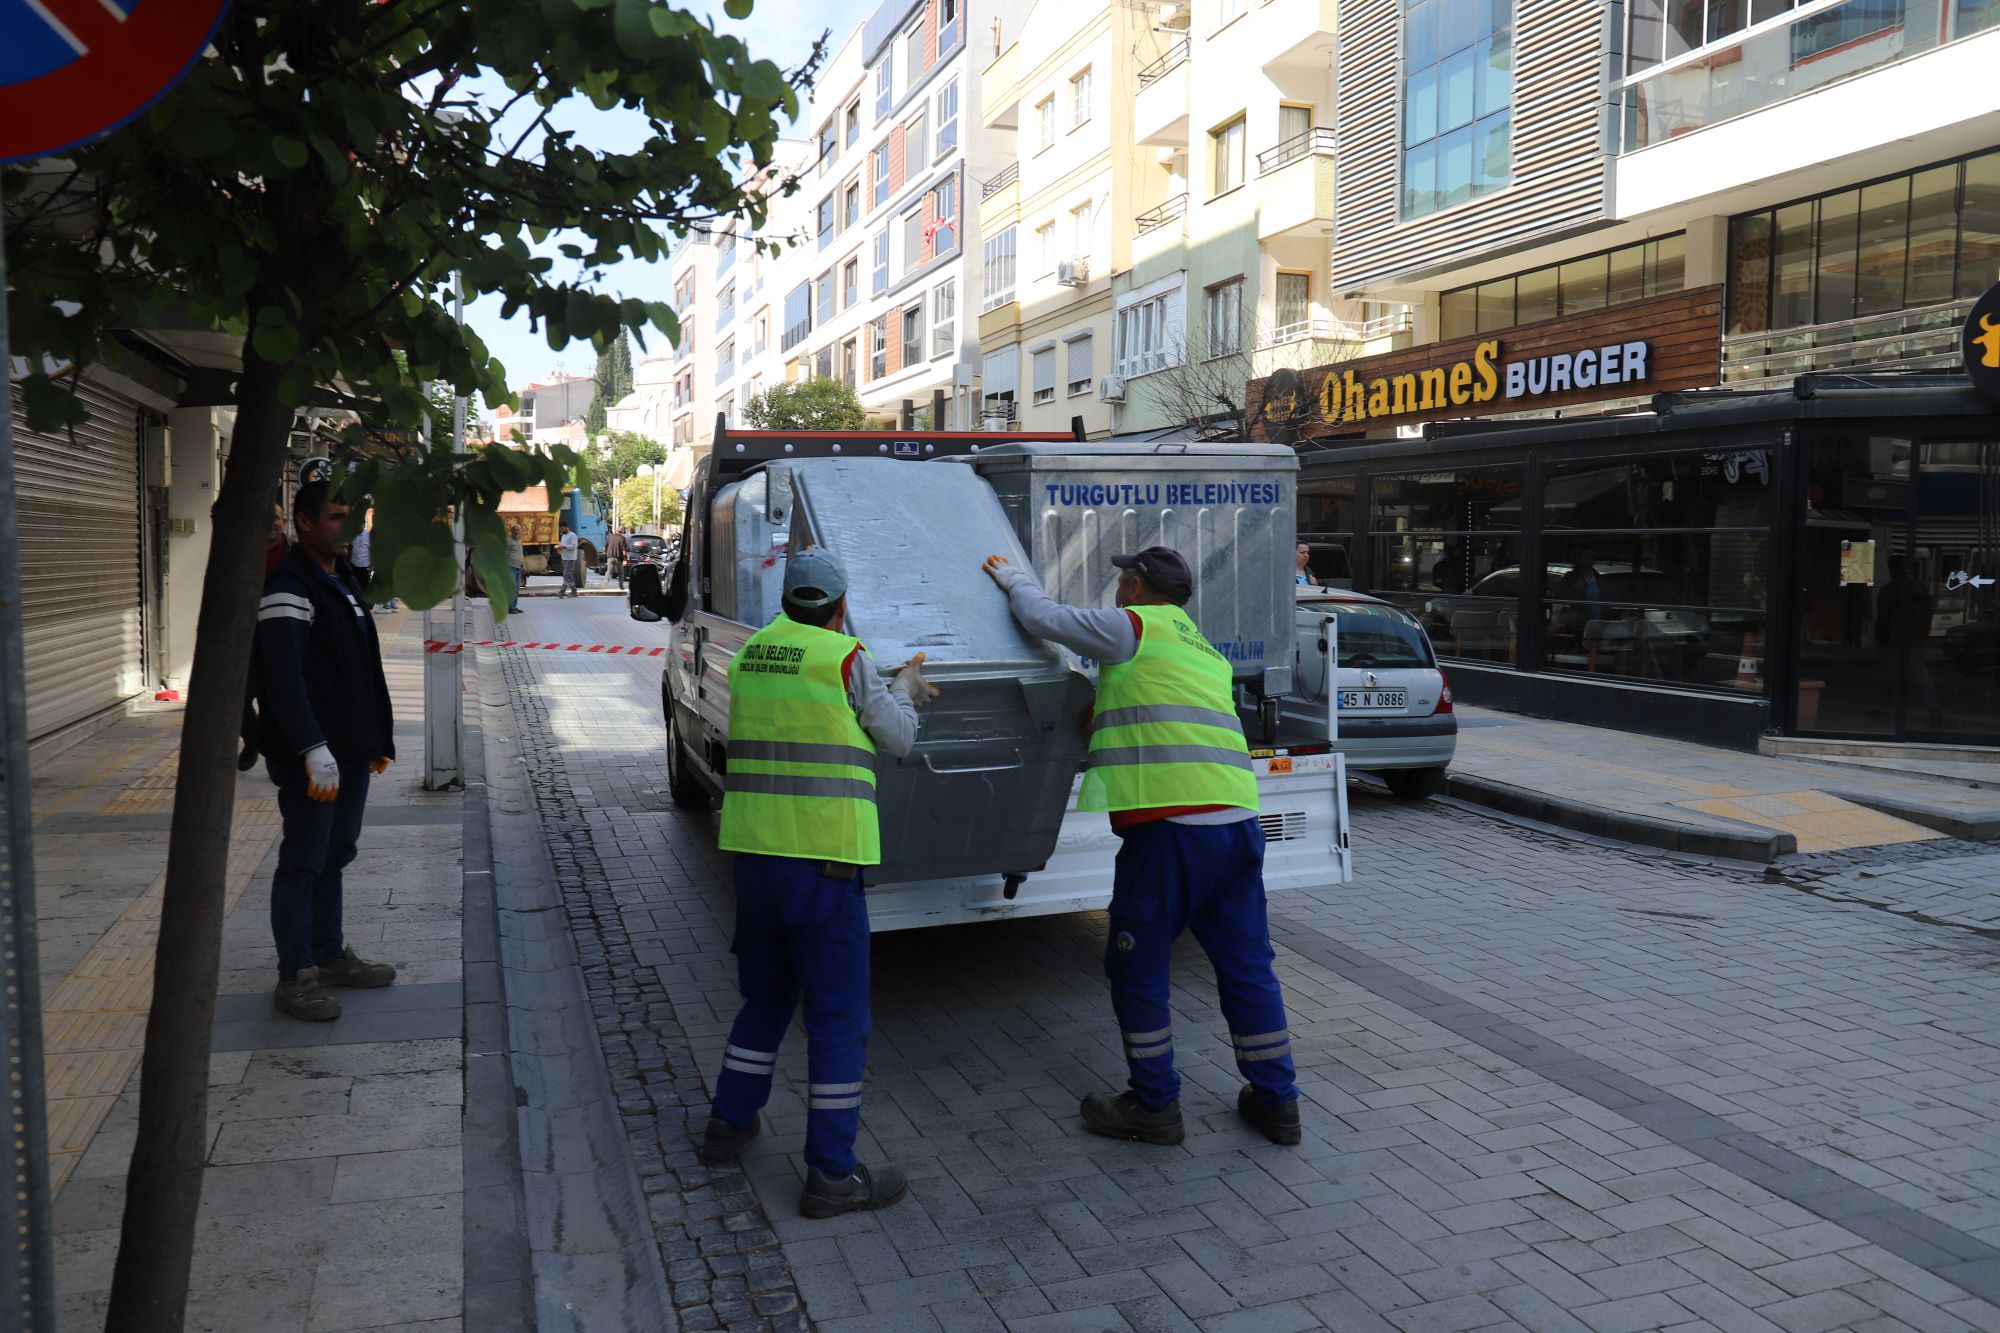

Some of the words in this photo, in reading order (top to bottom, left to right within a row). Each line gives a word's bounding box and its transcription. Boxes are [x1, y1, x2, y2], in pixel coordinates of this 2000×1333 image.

[1505, 341, 1648, 398] BURGER
[1046, 484, 1159, 506] TURGUTLU
[1166, 480, 1280, 505] BELEDİYESİ
[1343, 693, 1357, 706] 45
[1364, 693, 1371, 706] N
[1377, 693, 1404, 706] 0886
